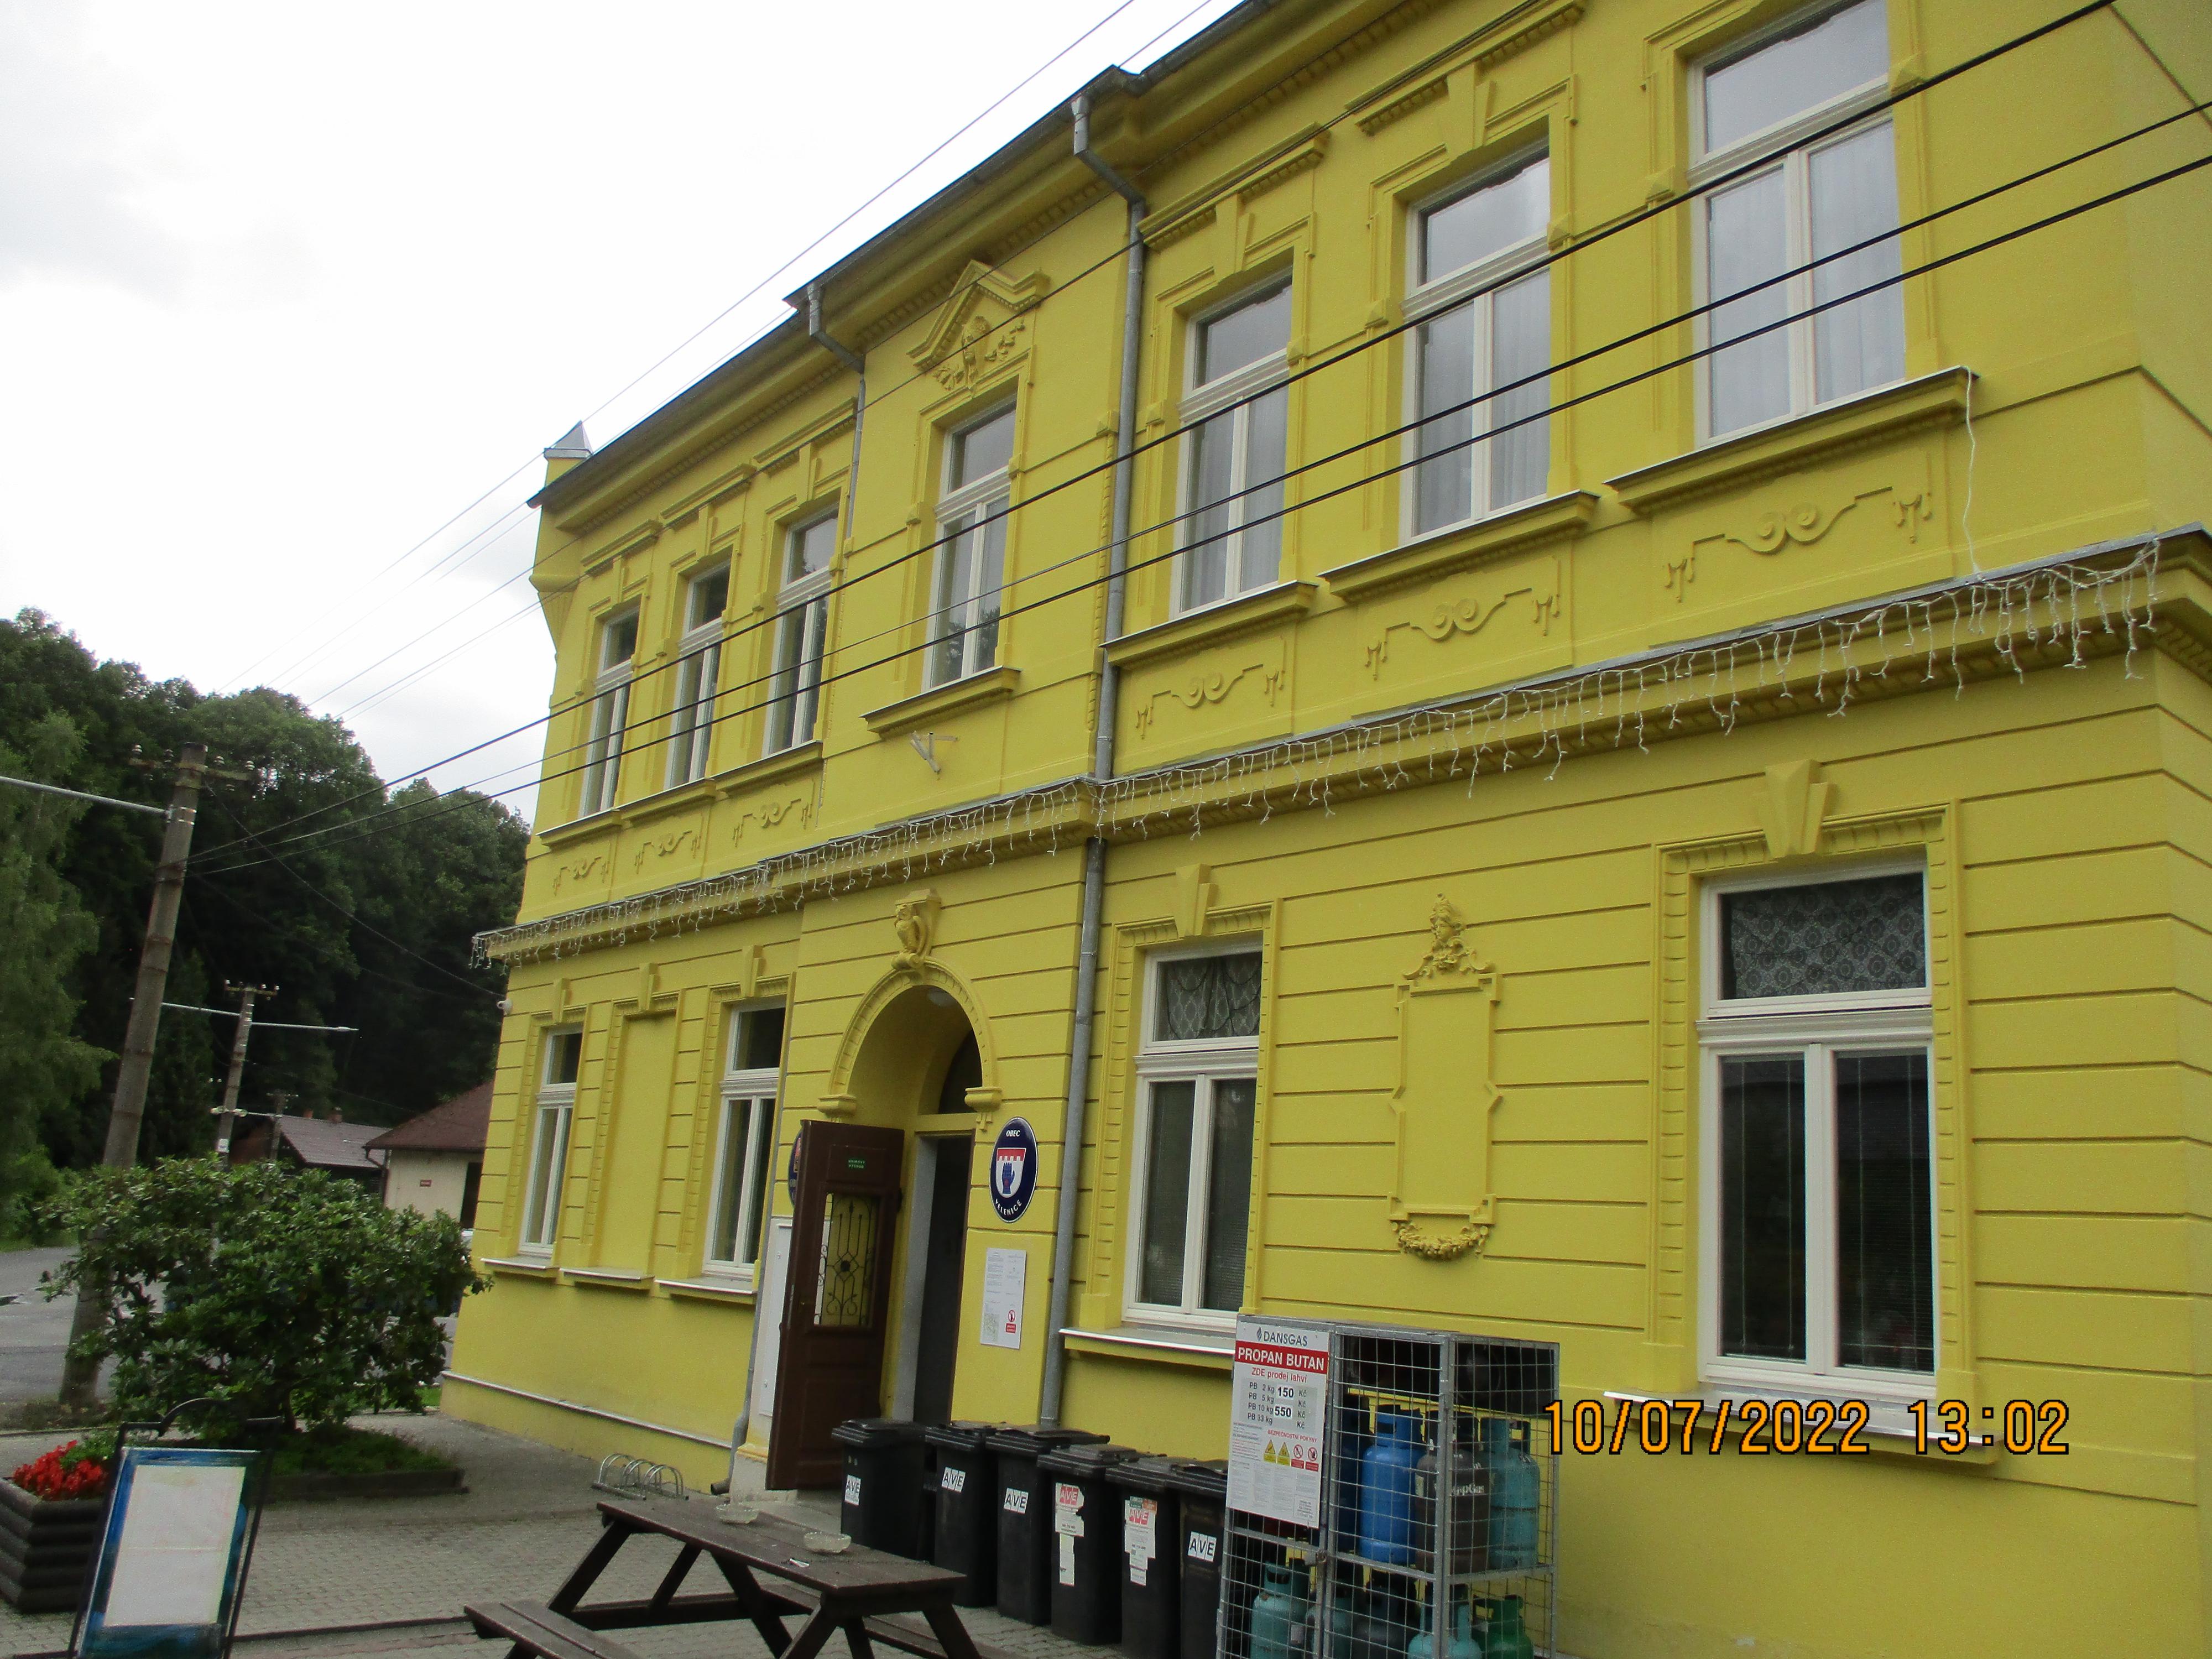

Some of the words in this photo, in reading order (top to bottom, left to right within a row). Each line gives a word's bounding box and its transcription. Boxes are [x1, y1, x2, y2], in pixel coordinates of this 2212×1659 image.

[1264, 1331, 1307, 1347] DANSGAS
[1238, 1347, 1282, 1365] PROPAN
[1286, 1353, 1324, 1370] BUTAN
[1251, 1367, 1265, 1376] ZDE
[1267, 1371, 1288, 1382] prodej
[1267, 1384, 1275, 1394] kg
[1277, 1386, 1294, 1398] 150
[1267, 1395, 1274, 1404] kg
[1266, 1405, 1274, 1414] kg
[1274, 1406, 1292, 1417] 550
[1265, 1415, 1273, 1425] kg
[846, 1480, 859, 1493] AVE
[942, 1472, 964, 1488] AVE
[1005, 1493, 1027, 1509] AVE
[1190, 1538, 1214, 1556] AVE
